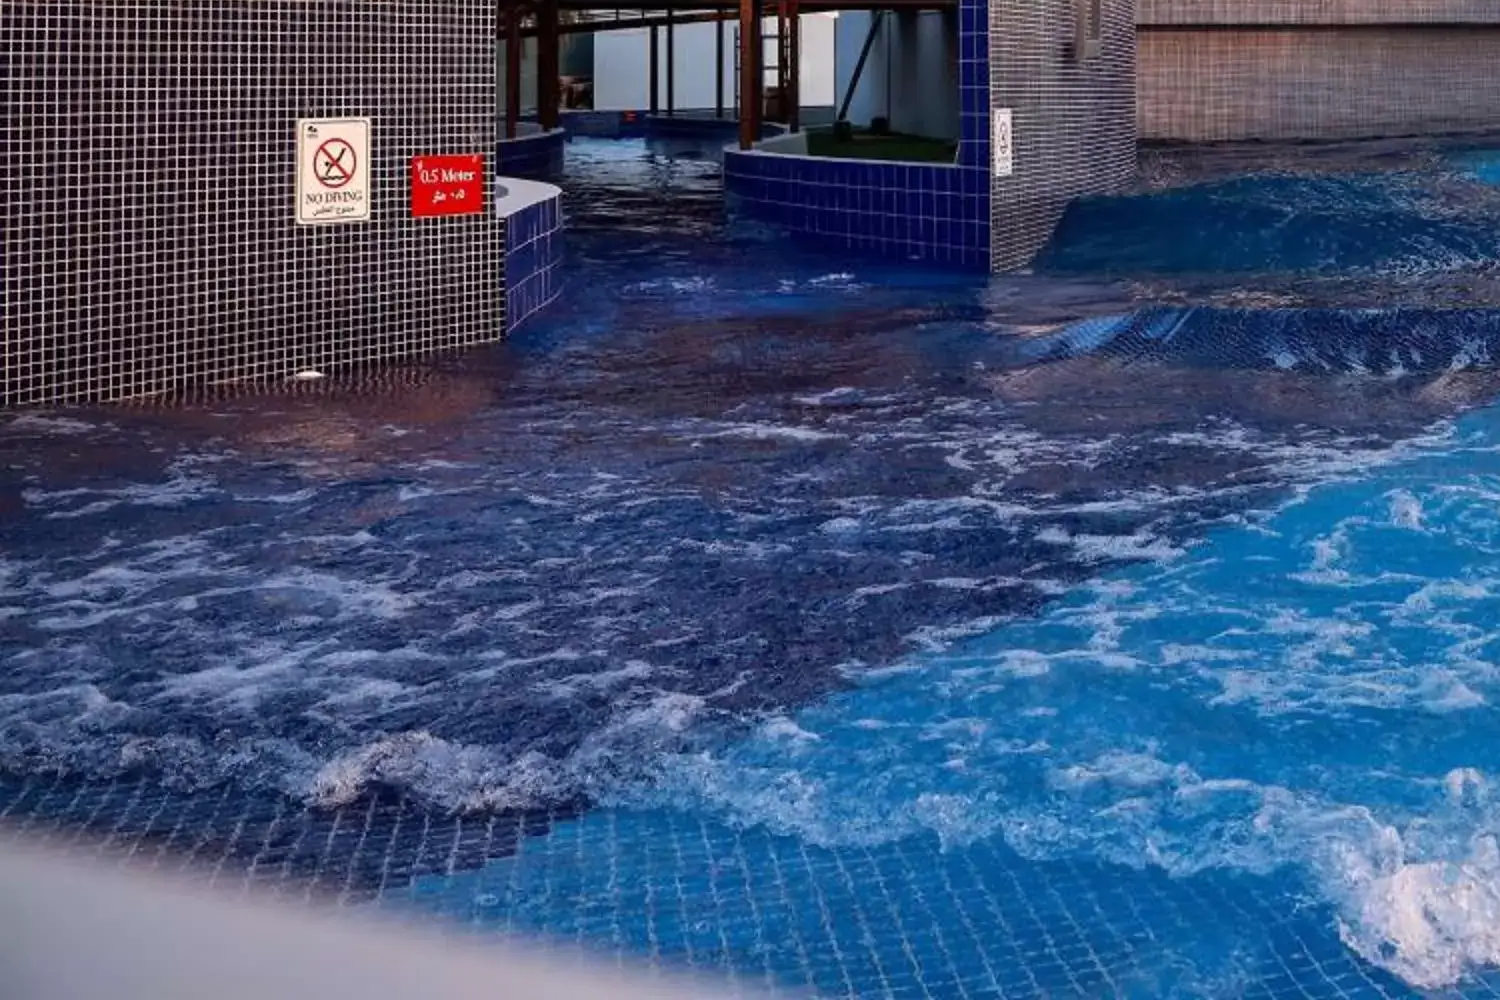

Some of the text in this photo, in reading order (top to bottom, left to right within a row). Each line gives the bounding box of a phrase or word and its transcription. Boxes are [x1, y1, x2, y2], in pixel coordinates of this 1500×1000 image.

[420, 168, 476, 184] 0.5 Meter
[305, 190, 363, 204] NO DIVING
